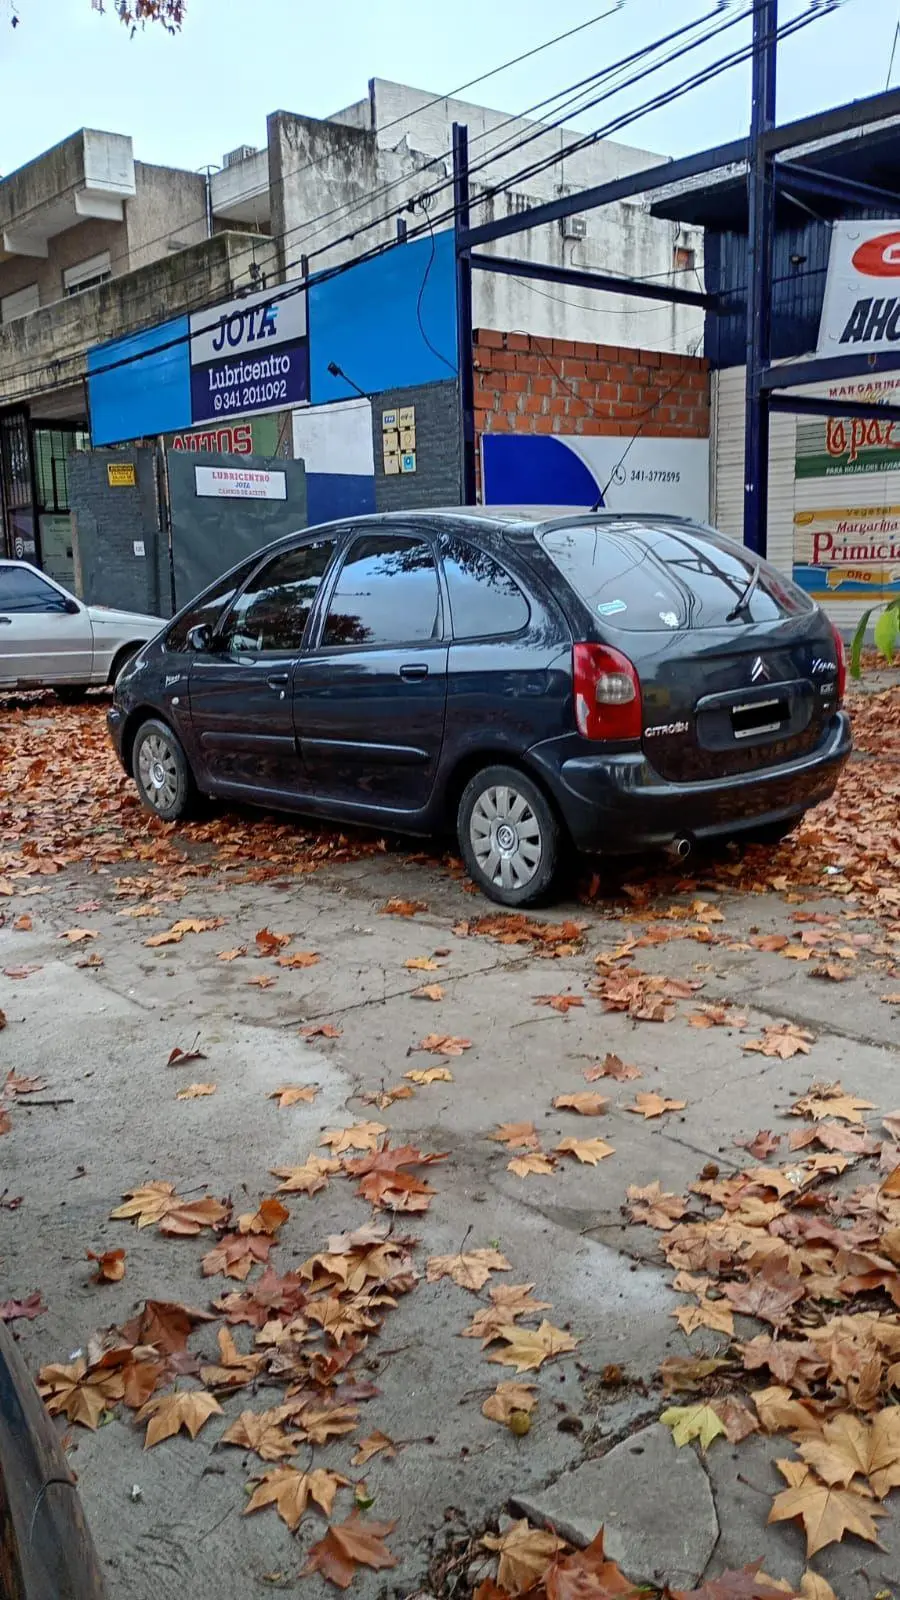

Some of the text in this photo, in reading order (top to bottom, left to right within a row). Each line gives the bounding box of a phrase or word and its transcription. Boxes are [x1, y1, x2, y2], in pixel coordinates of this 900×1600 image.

[212, 304, 278, 351] JOTA
[208, 355, 290, 391] Lubricentro
[223, 379, 287, 409] 341 2011092
[172, 423, 252, 456] AUTOS
[212, 471, 270, 482] LUBRICENTRO
[846, 507, 892, 516] Vegetal
[847, 570, 872, 581] ORO
